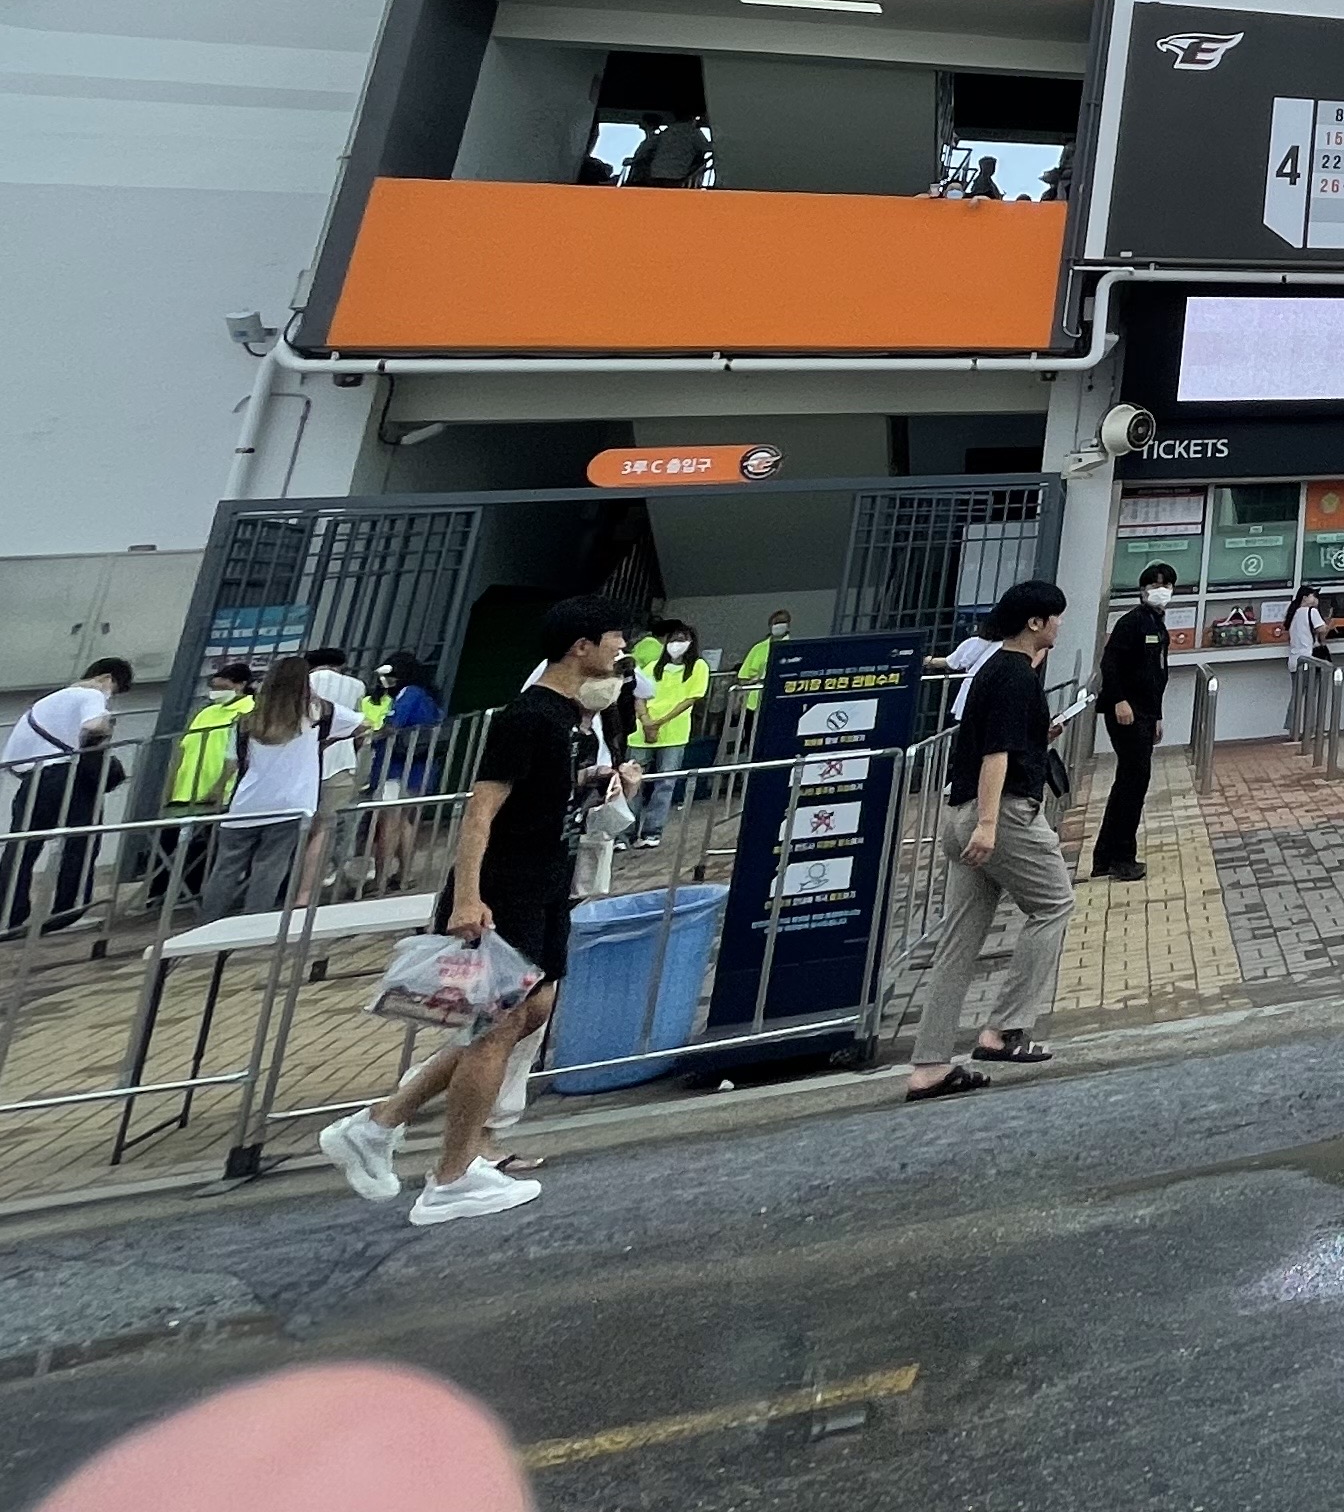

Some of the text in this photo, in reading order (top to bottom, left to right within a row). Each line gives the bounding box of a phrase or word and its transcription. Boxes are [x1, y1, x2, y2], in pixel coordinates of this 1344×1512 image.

[1276, 145, 1301, 185] 4
[1142, 439, 1229, 459] TICKETS
[651, 460, 662, 474] C
